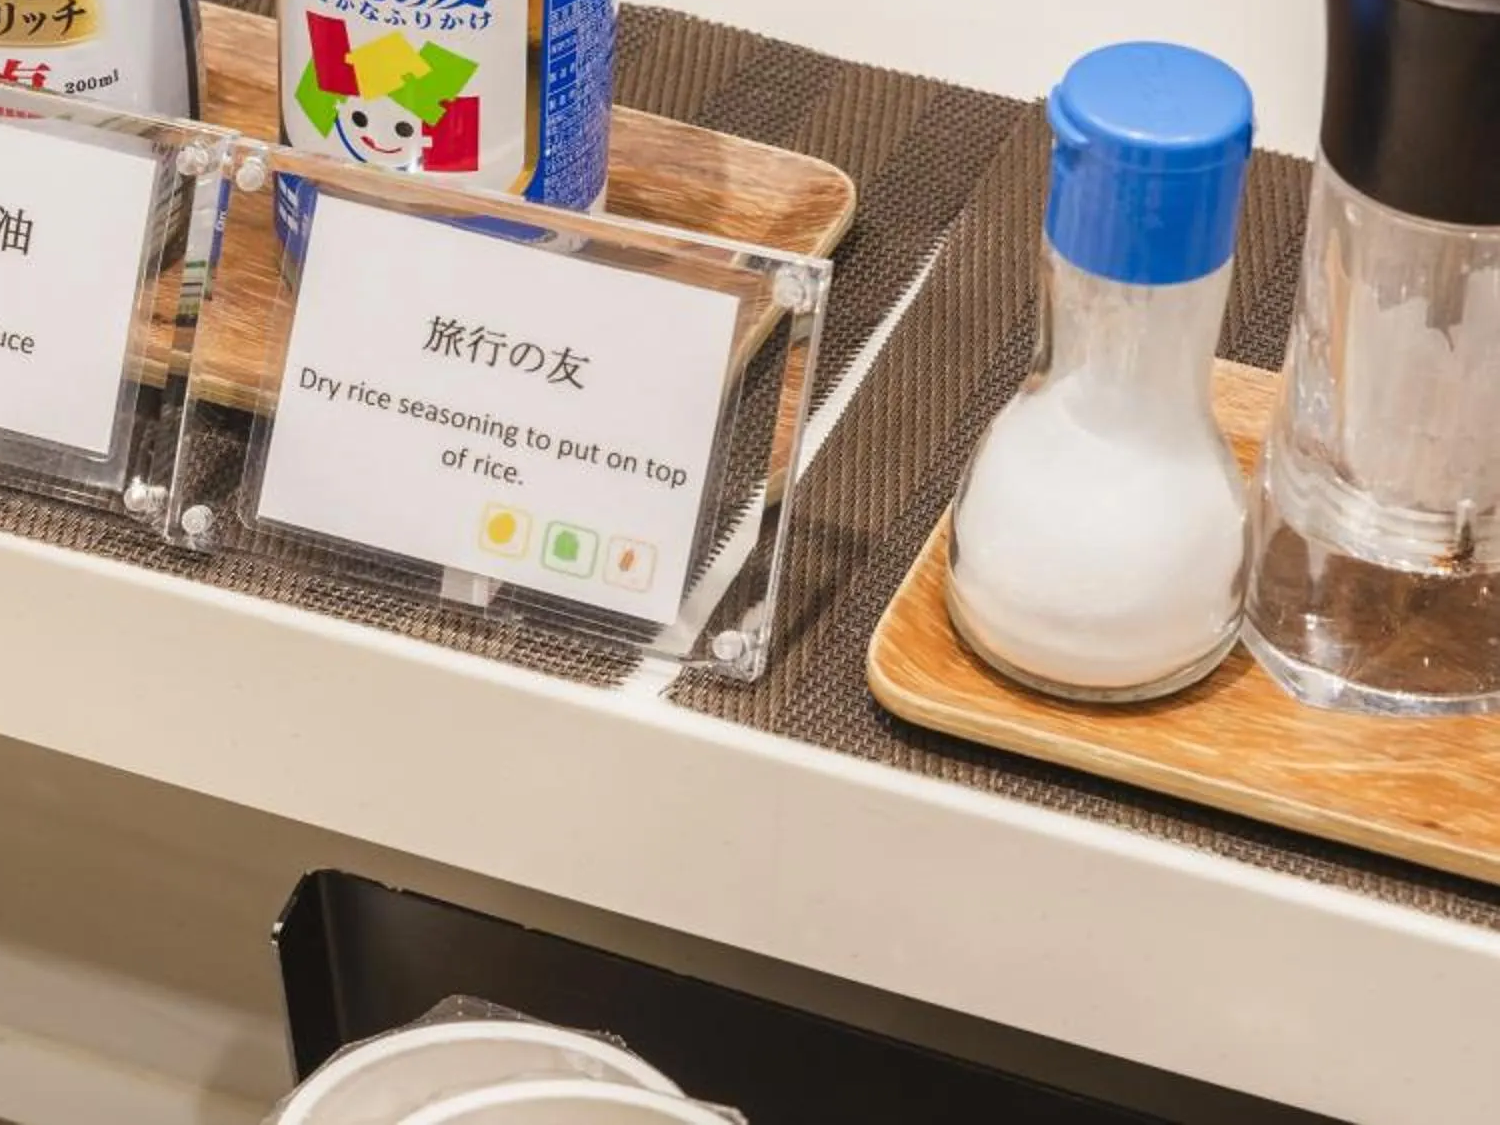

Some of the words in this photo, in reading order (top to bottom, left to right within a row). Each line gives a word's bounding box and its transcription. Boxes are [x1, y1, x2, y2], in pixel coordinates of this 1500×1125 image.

[64, 68, 120, 95] 200ml
[422, 315, 591, 391] 旅行の友
[299, 366, 342, 401] Dry
[346, 381, 392, 410] rice
[397, 395, 519, 449] seasoning
[526, 427, 552, 451] to
[557, 436, 601, 465] put
[606, 449, 638, 473] on
[646, 458, 688, 490] top
[441, 447, 470, 469] of
[473, 457, 525, 487] rice.
